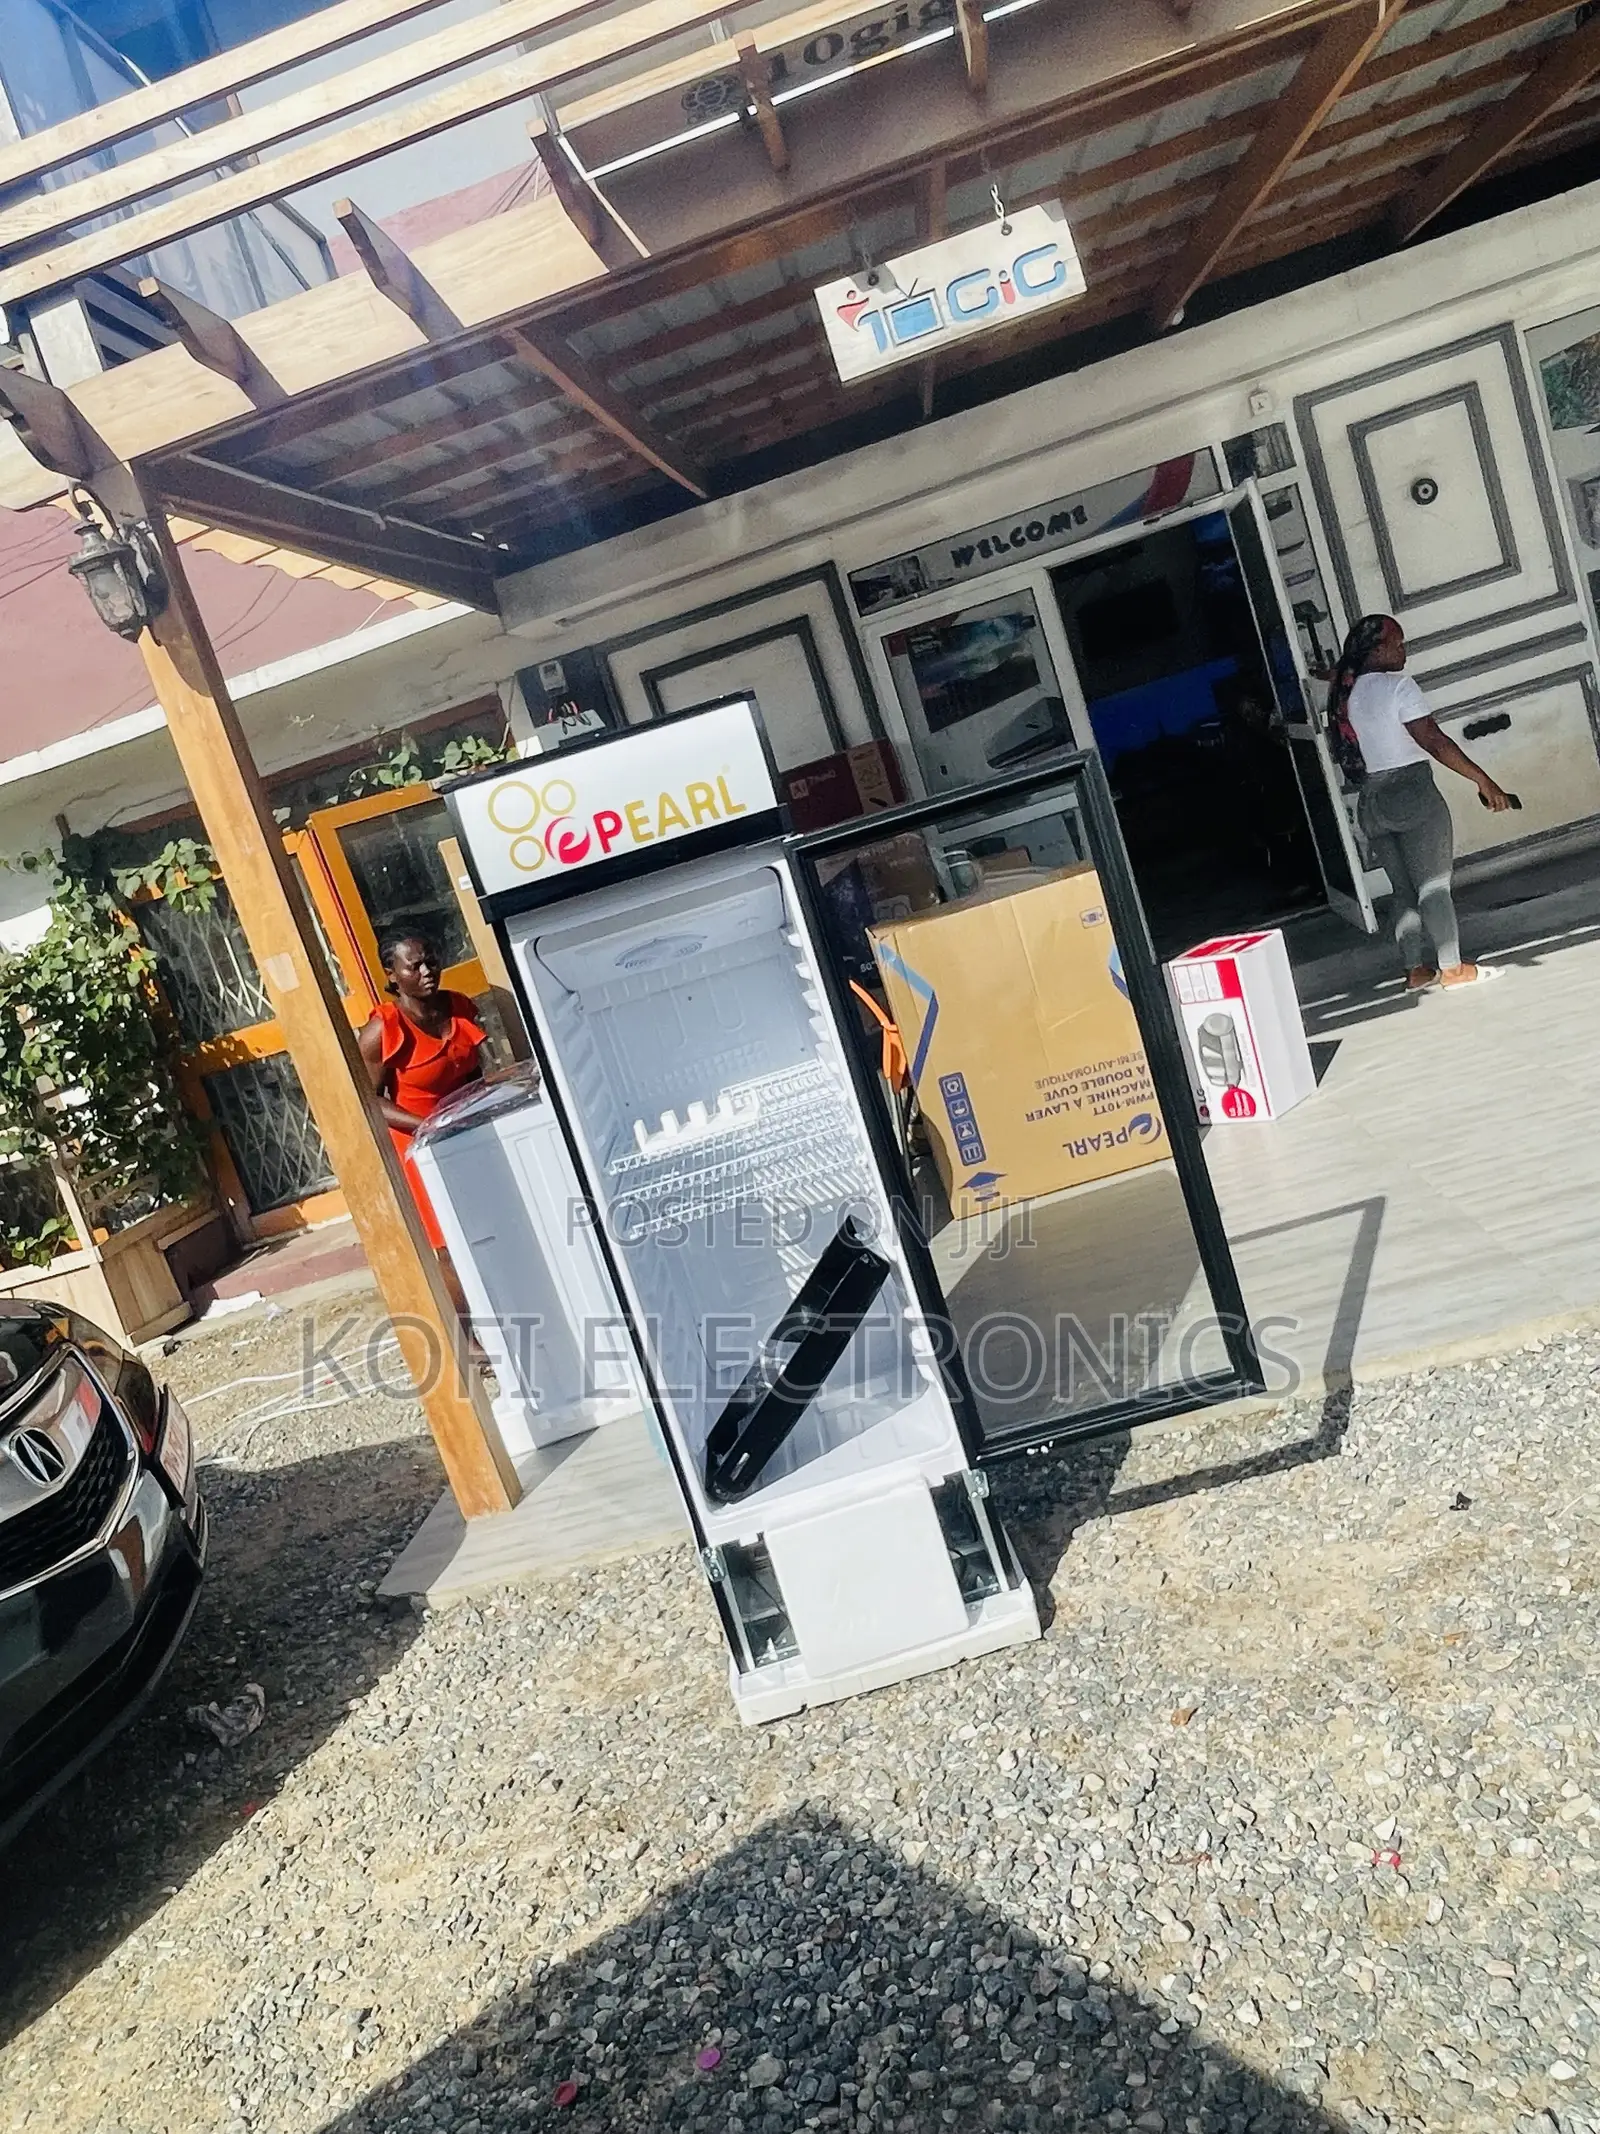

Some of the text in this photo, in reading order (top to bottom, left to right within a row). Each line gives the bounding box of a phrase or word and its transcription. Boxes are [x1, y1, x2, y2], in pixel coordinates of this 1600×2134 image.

[950, 504, 1088, 569] WELCOME
[1035, 1050, 1145, 1090] SEMI-AUTOMATIQUE
[1081, 1067, 1133, 1091] DOUBLE
[1043, 1084, 1079, 1102] CUVE
[1087, 1077, 1152, 1104] MACHINE
[1025, 1102, 1071, 1122] LAVER
